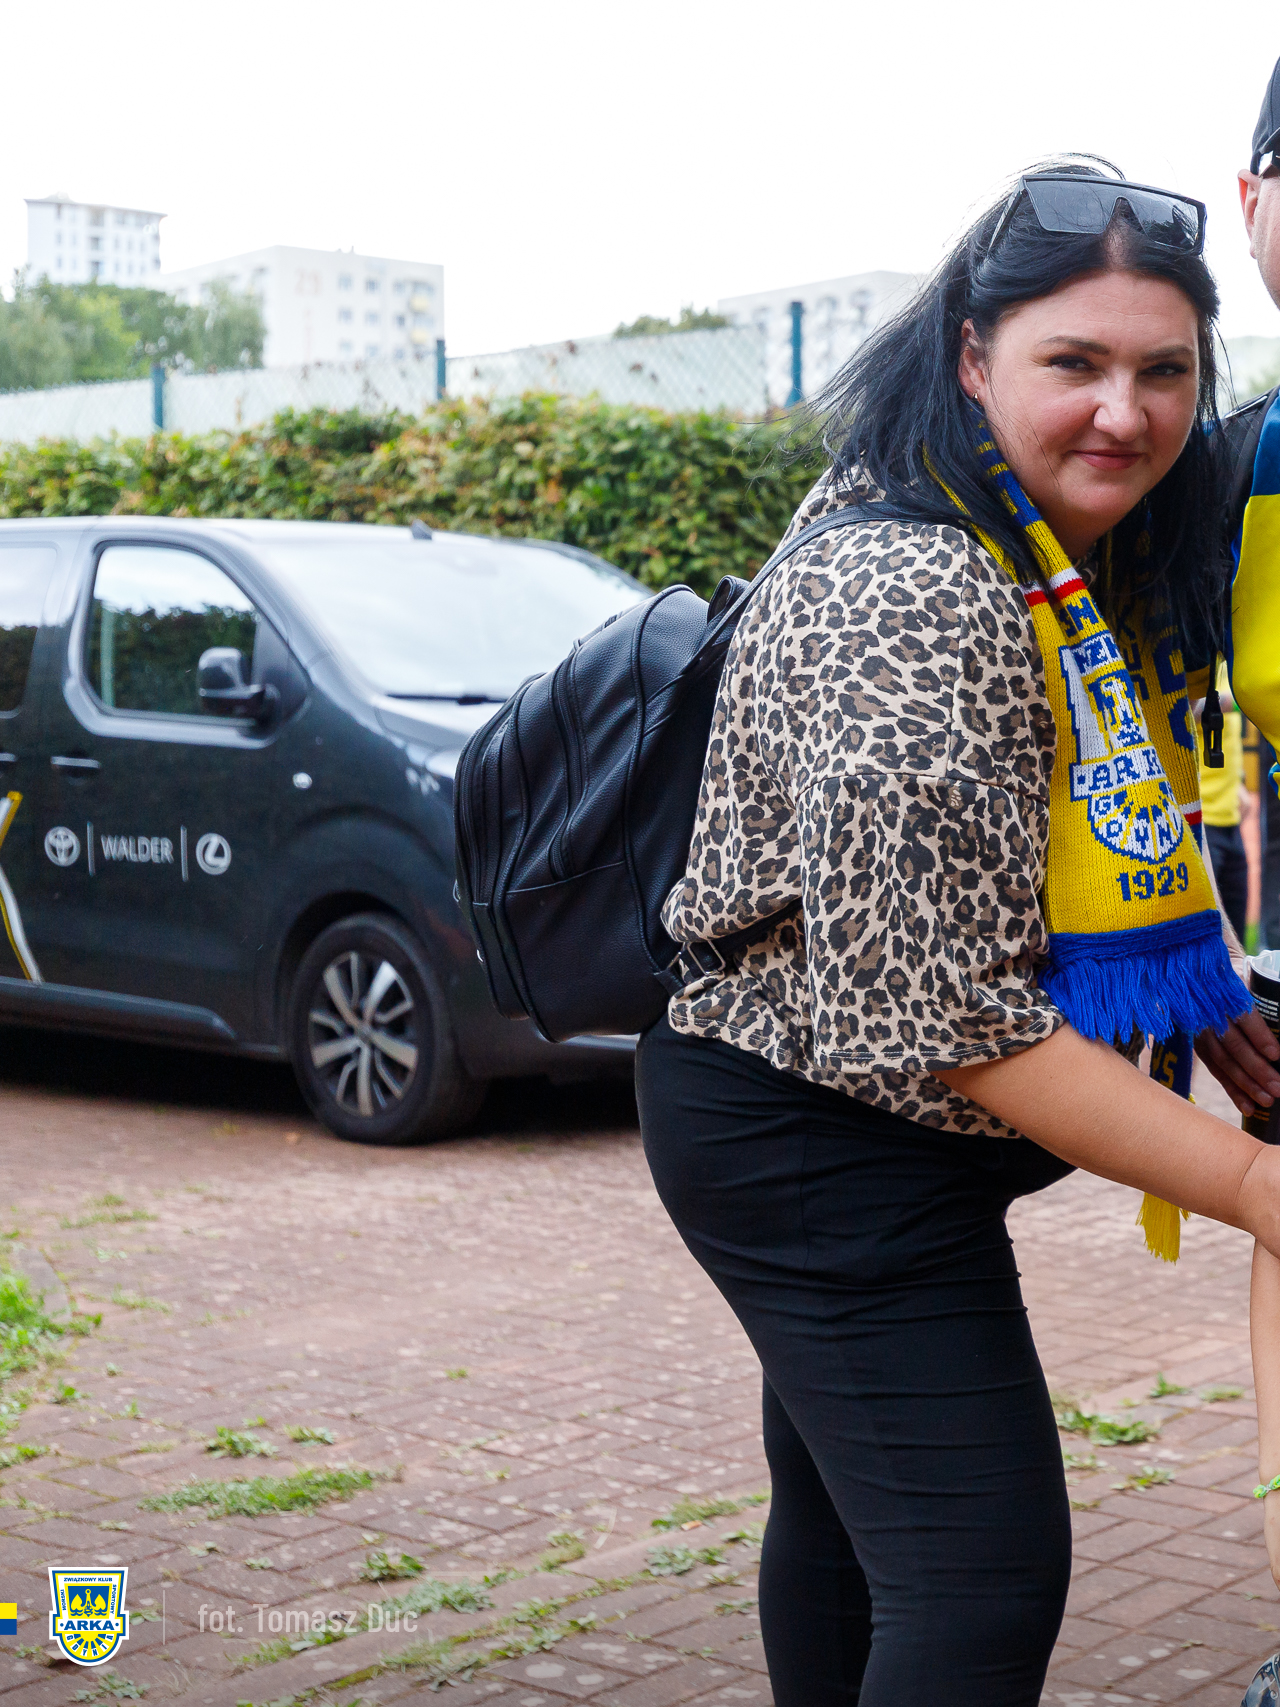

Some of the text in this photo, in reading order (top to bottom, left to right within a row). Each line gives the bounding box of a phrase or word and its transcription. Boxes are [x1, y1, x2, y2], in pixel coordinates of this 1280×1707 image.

[1088, 750, 1166, 791] ARK
[100, 834, 174, 864] WALDER
[1116, 862, 1189, 901] 1929
